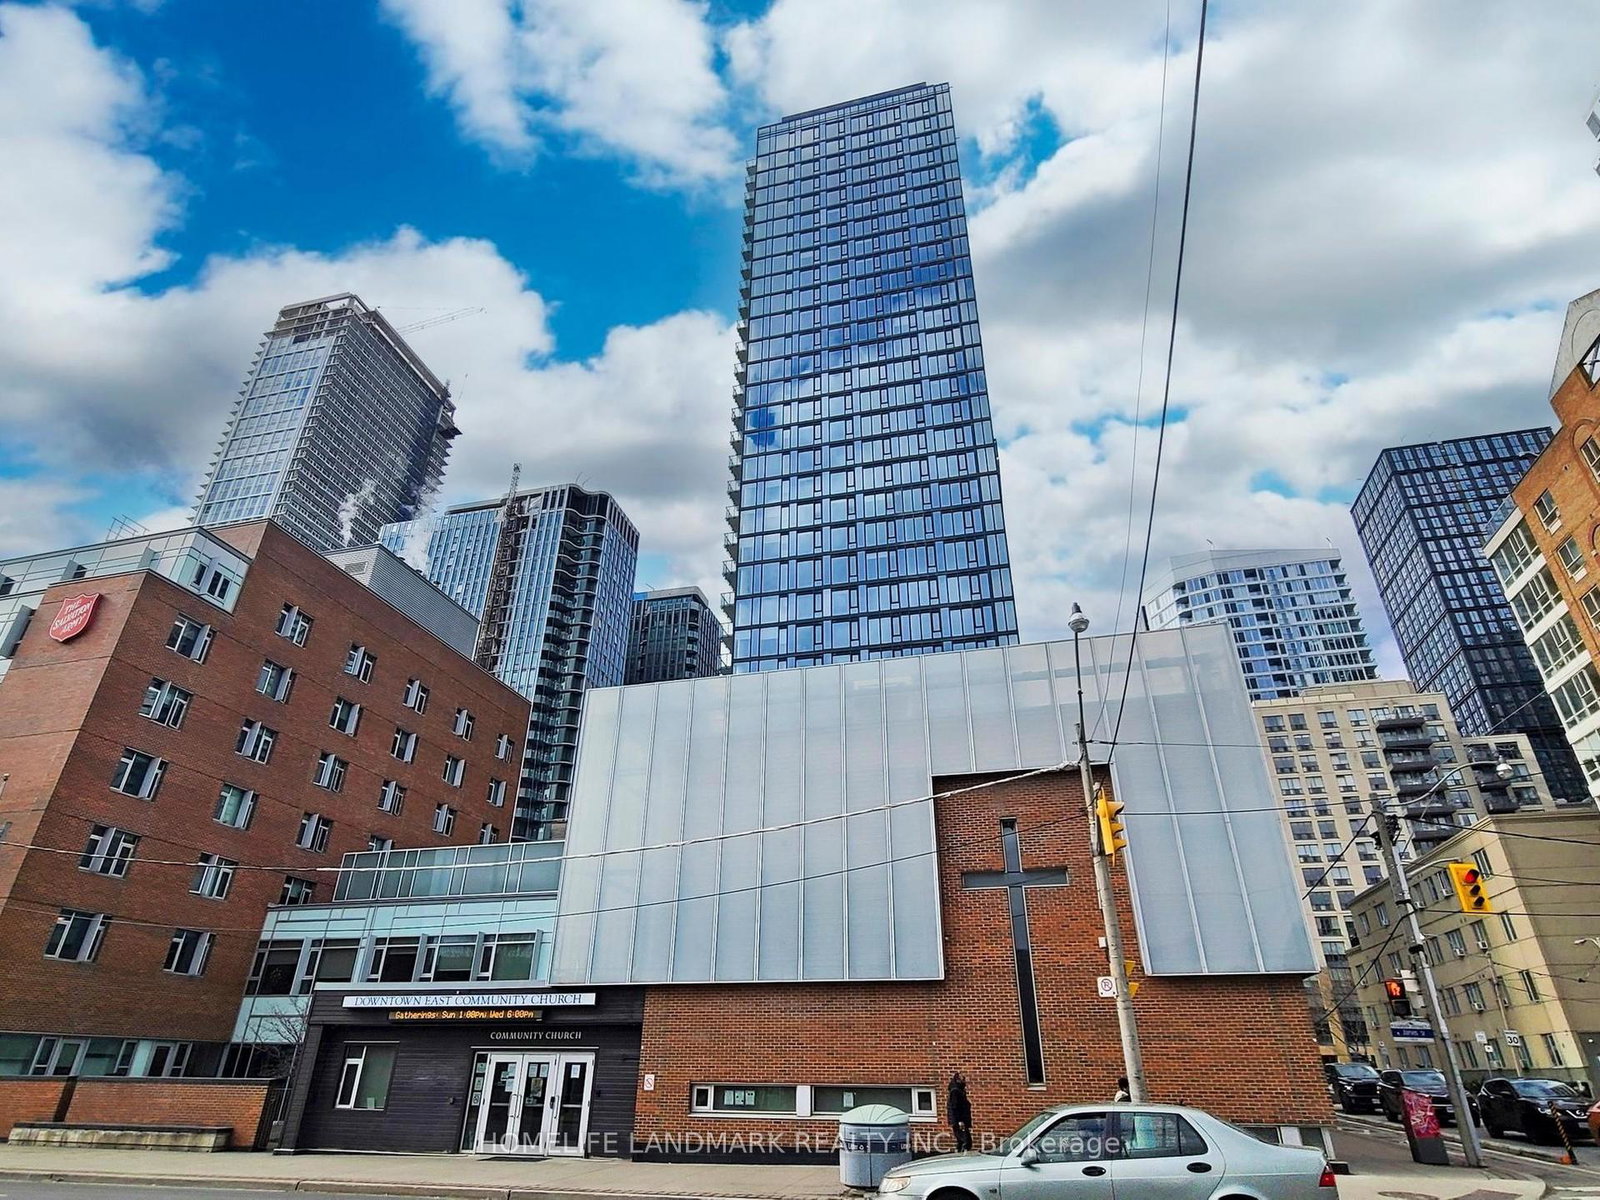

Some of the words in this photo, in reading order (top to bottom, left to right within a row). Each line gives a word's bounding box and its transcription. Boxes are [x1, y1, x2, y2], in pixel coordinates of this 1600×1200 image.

[354, 996, 421, 1006] DOWNTOWN
[424, 996, 452, 1006] EAST
[454, 995, 528, 1005] COMMUNITY
[530, 994, 582, 1004] CHURCH
[441, 1010, 456, 1019] Sun
[489, 1010, 505, 1019] Wed
[490, 1031, 543, 1040] COMMUNITY
[545, 1031, 582, 1040] CHURCH
[1507, 1036, 1519, 1044] 30
